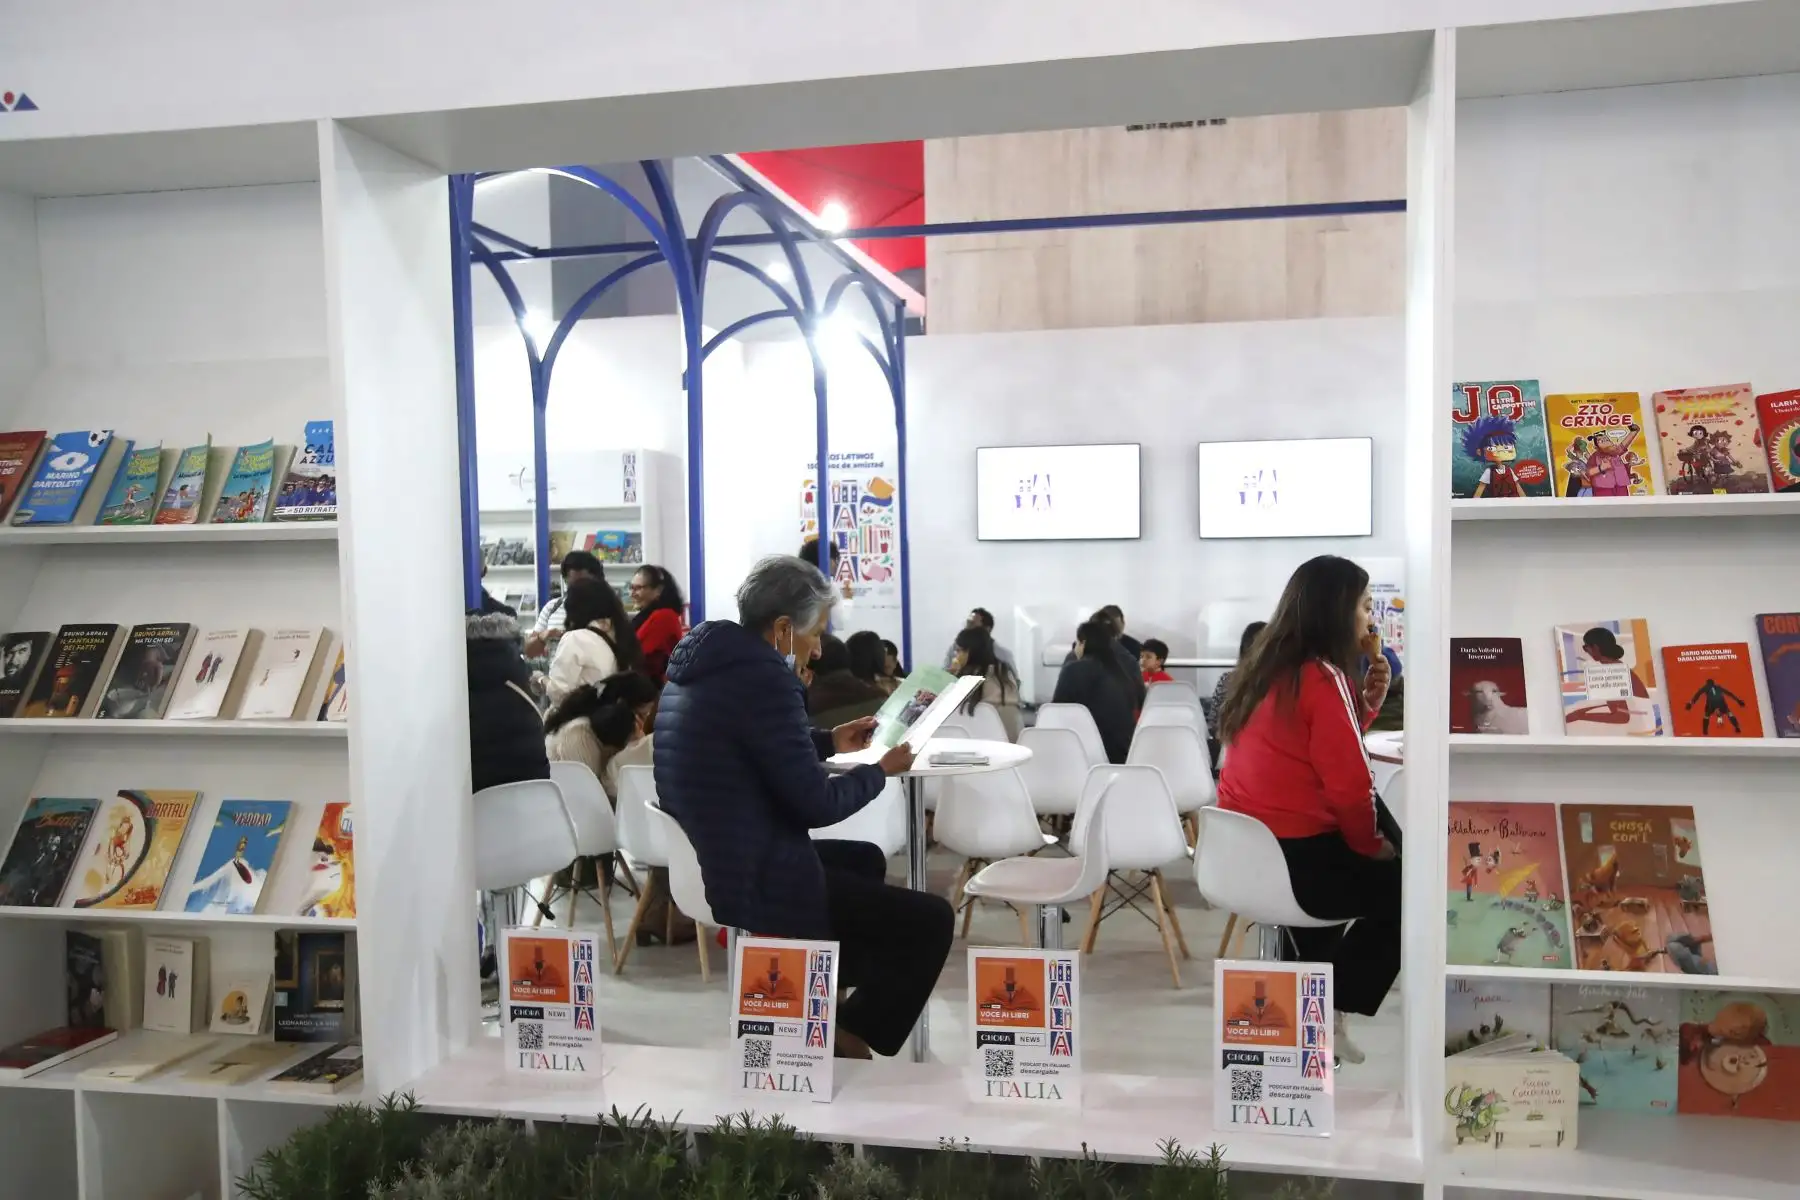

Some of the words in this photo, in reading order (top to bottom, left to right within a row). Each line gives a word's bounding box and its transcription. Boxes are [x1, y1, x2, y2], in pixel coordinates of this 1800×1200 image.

[1452, 385, 1524, 423] JO
[1578, 404, 1612, 415] ZIO
[1770, 400, 1798, 408] ILARIA
[1562, 414, 1632, 427] CRINGE
[304, 444, 334, 454] CAL
[300, 455, 334, 464] AZZU
[1764, 616, 1800, 634] COR
[146, 802, 189, 818] BARTALI
[1260, 1028, 1280, 1036] LIBRI
[519, 1052, 586, 1072] ITALIA
[776, 1060, 812, 1068] descargable
[742, 1072, 814, 1093] ITALIA
[985, 1080, 1063, 1100] ITALIA
[1269, 1092, 1311, 1100] descargable
[1232, 1104, 1314, 1128] ITALIA
